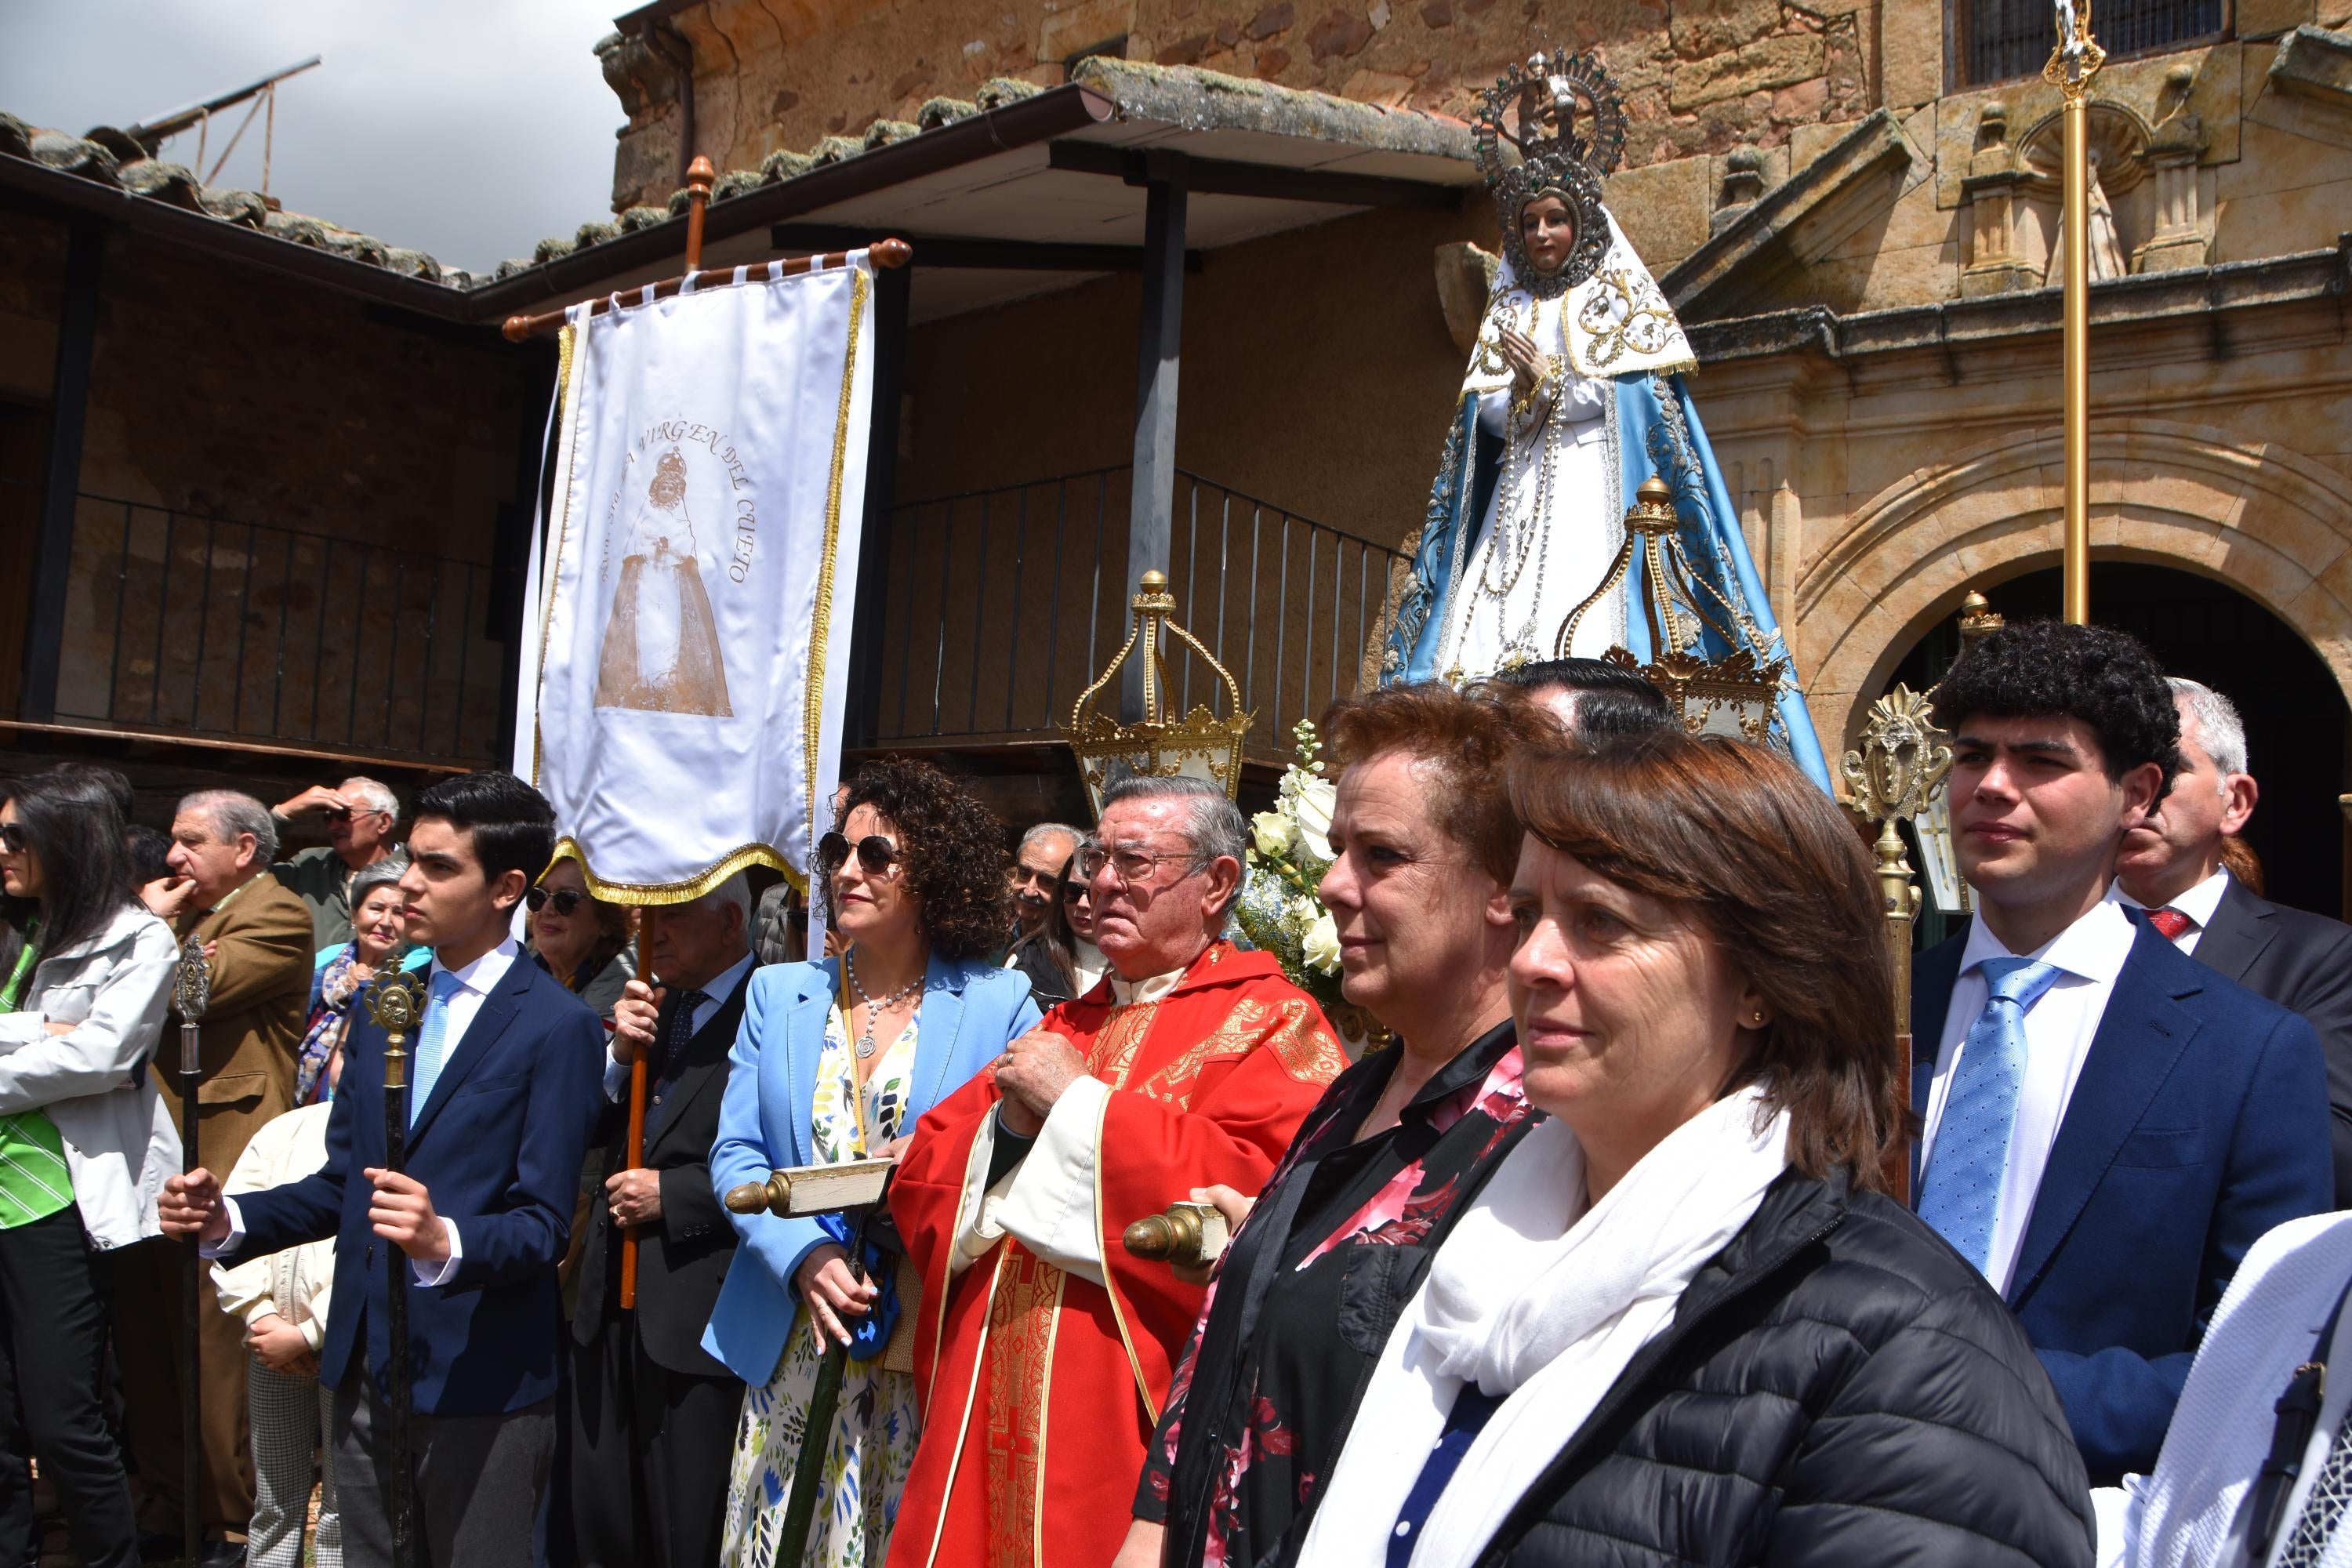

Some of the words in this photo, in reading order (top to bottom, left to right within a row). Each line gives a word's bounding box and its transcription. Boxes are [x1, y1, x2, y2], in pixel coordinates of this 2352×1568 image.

[639, 420, 728, 455] VIRGEN
[721, 446, 750, 490] DEL
[729, 499, 755, 583] CUETO
